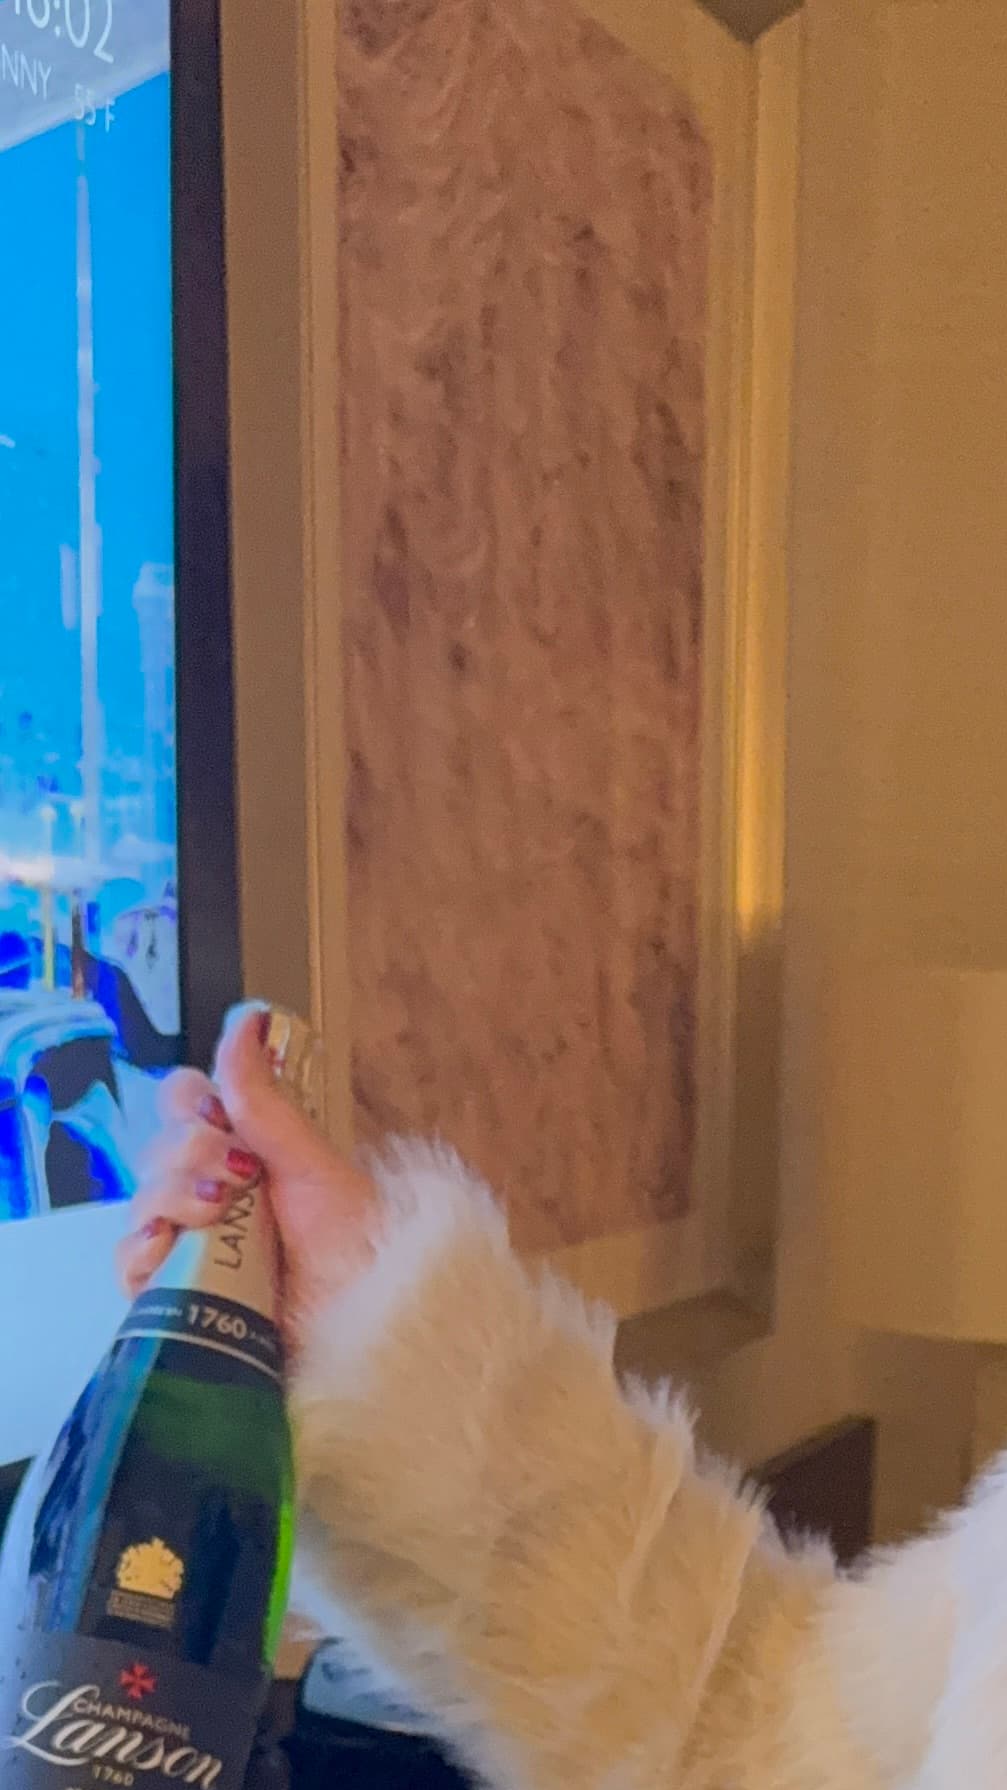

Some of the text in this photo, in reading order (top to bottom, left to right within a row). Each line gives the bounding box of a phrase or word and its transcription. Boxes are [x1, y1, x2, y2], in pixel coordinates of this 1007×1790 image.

[15, 0, 115, 64] :02
[187, 1303, 248, 1341] 1760
[72, 1698, 191, 1740] CHAMPAGNE
[92, 1763, 134, 1787] 1760
